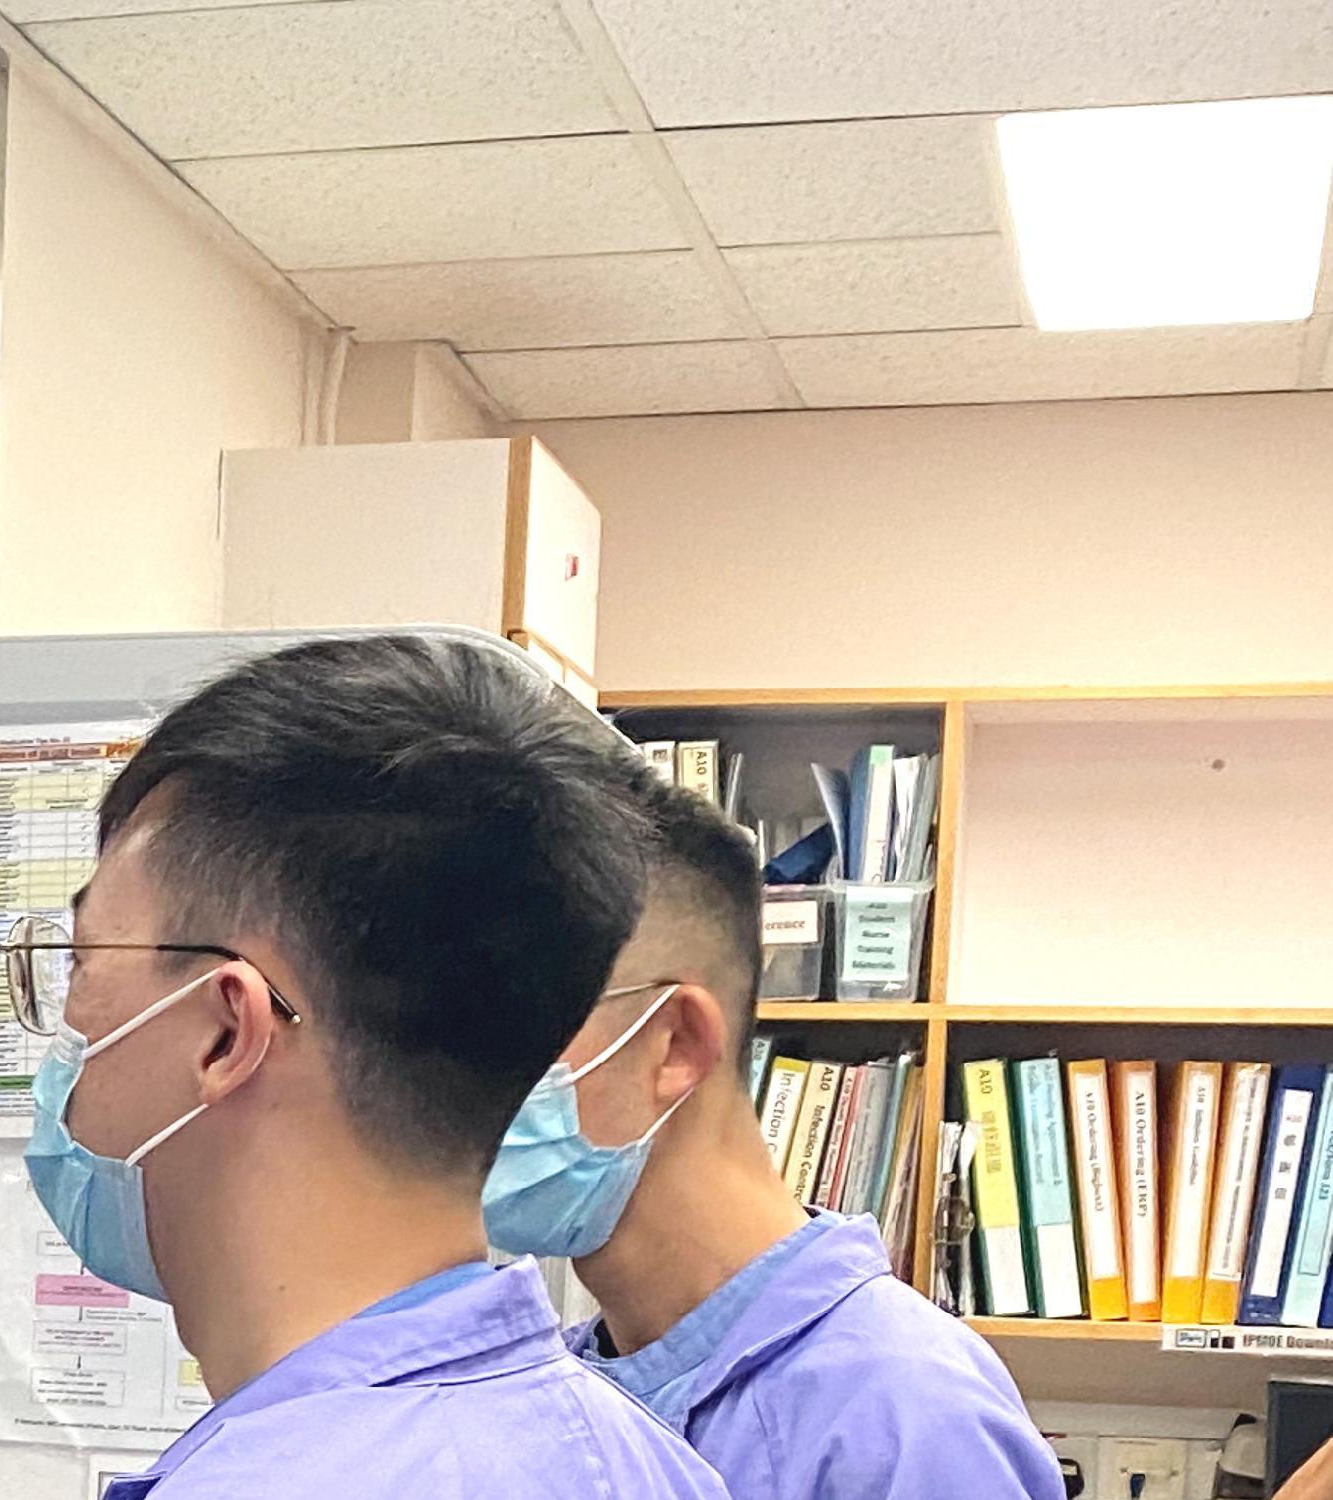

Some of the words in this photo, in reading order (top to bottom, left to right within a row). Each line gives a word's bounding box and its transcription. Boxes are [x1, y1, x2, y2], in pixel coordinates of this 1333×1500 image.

[764, 918, 806, 931] erence
[821, 1066, 834, 1091] A10
[980, 1068, 994, 1094] A10
[768, 1072, 795, 1138] Infection
[1136, 1091, 1145, 1115] A10
[803, 1103, 825, 1158] Infection
[1136, 1119, 1146, 1176] Ordering
